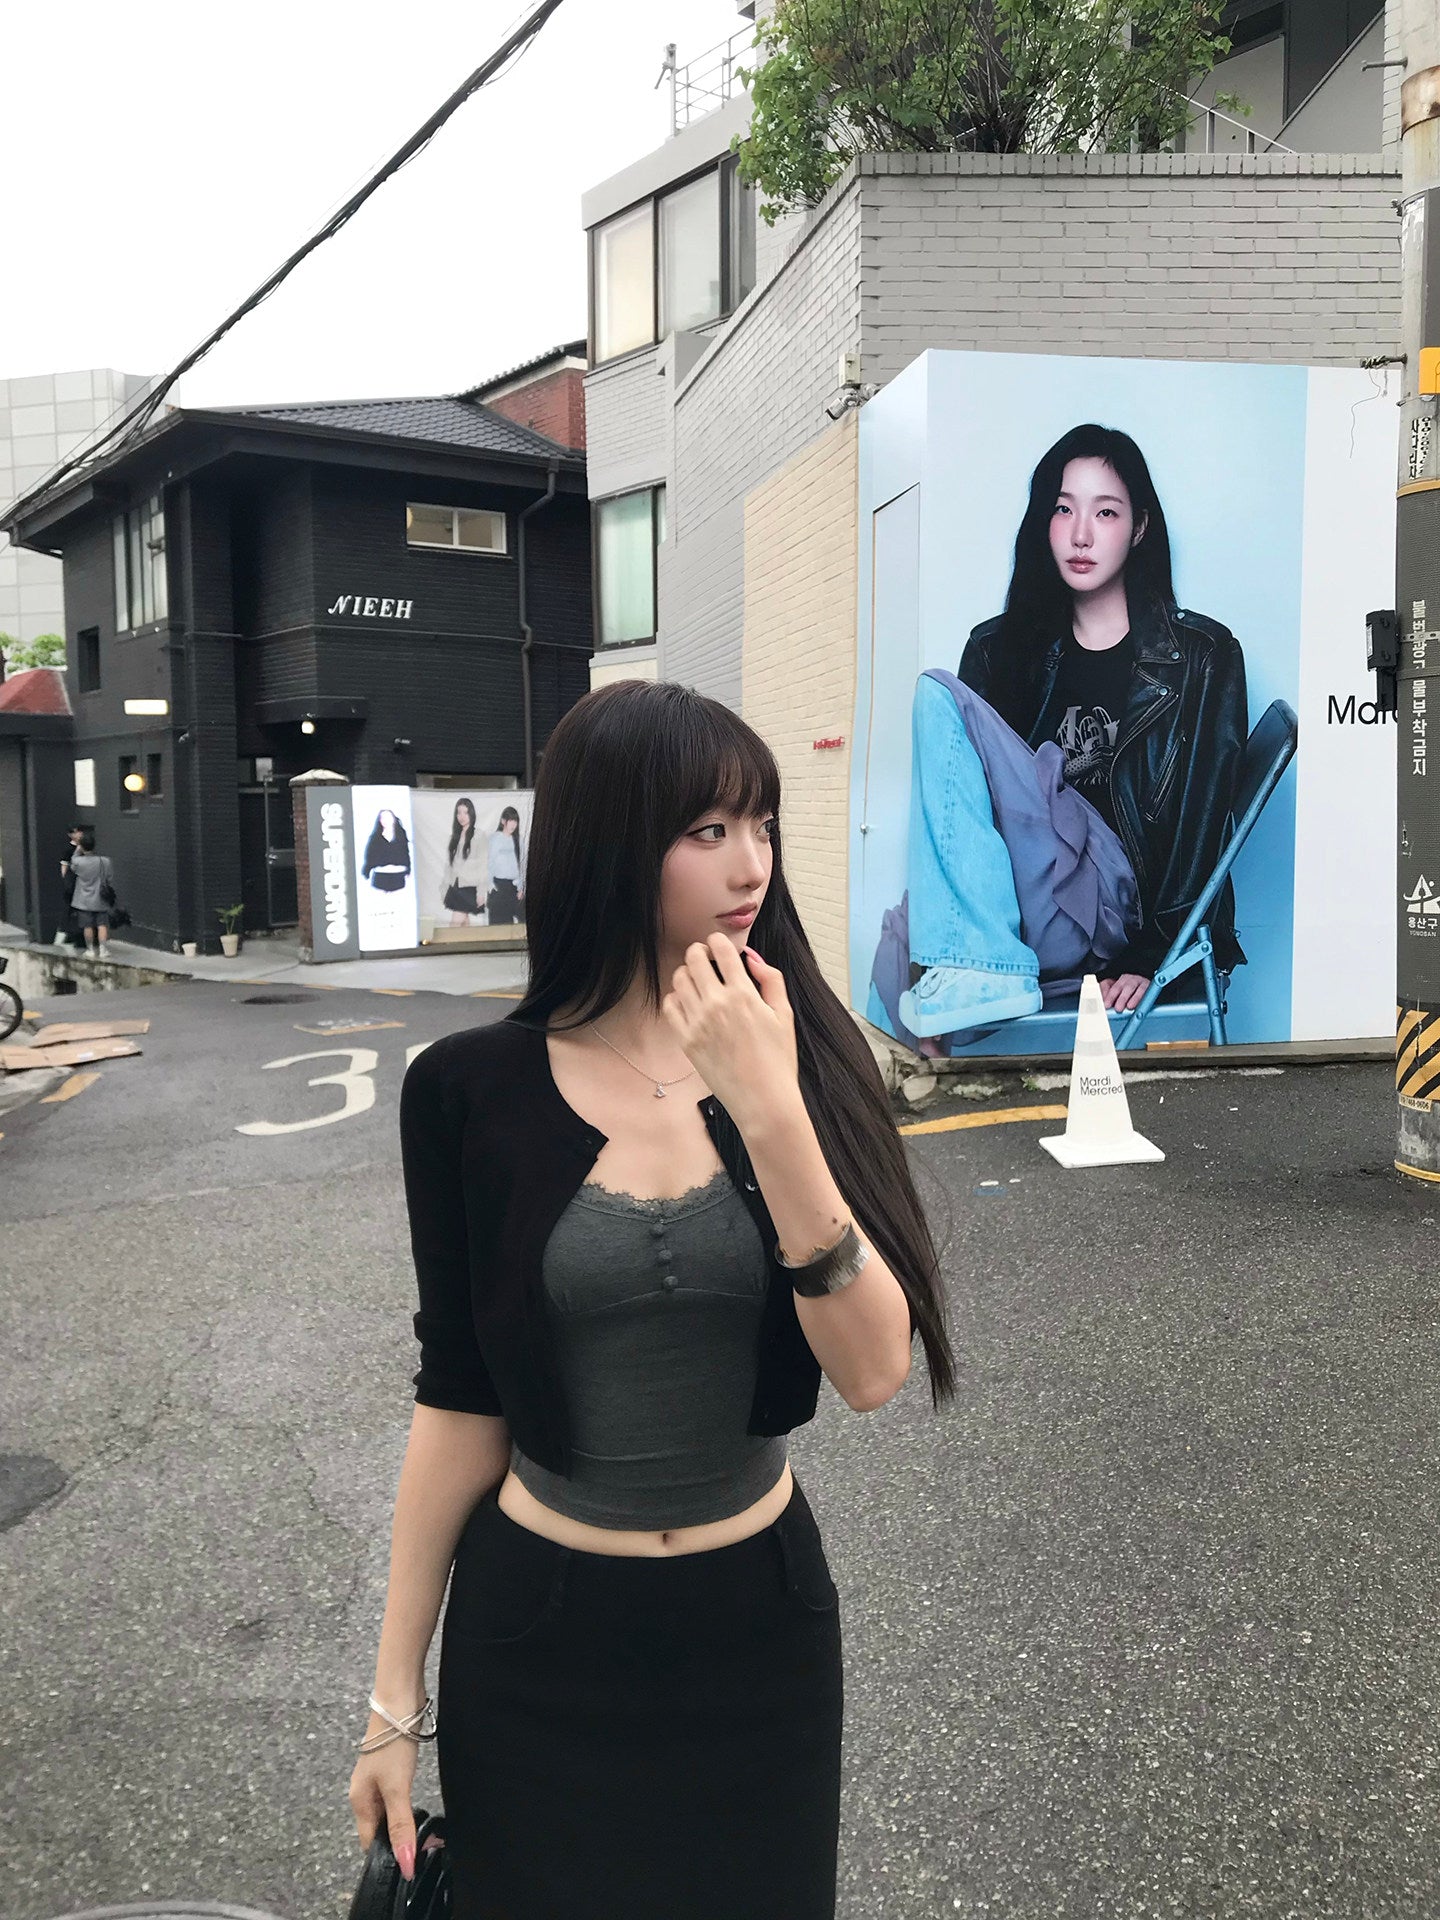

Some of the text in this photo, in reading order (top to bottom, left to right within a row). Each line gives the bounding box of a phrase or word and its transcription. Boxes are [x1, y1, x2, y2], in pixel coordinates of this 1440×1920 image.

[327, 595, 414, 619] NIEEH
[1327, 695, 1397, 725] Mar
[1408, 916, 1438, 930] 용산구
[234, 1041, 436, 1136] 3
[1080, 1076, 1111, 1087] Mardi
